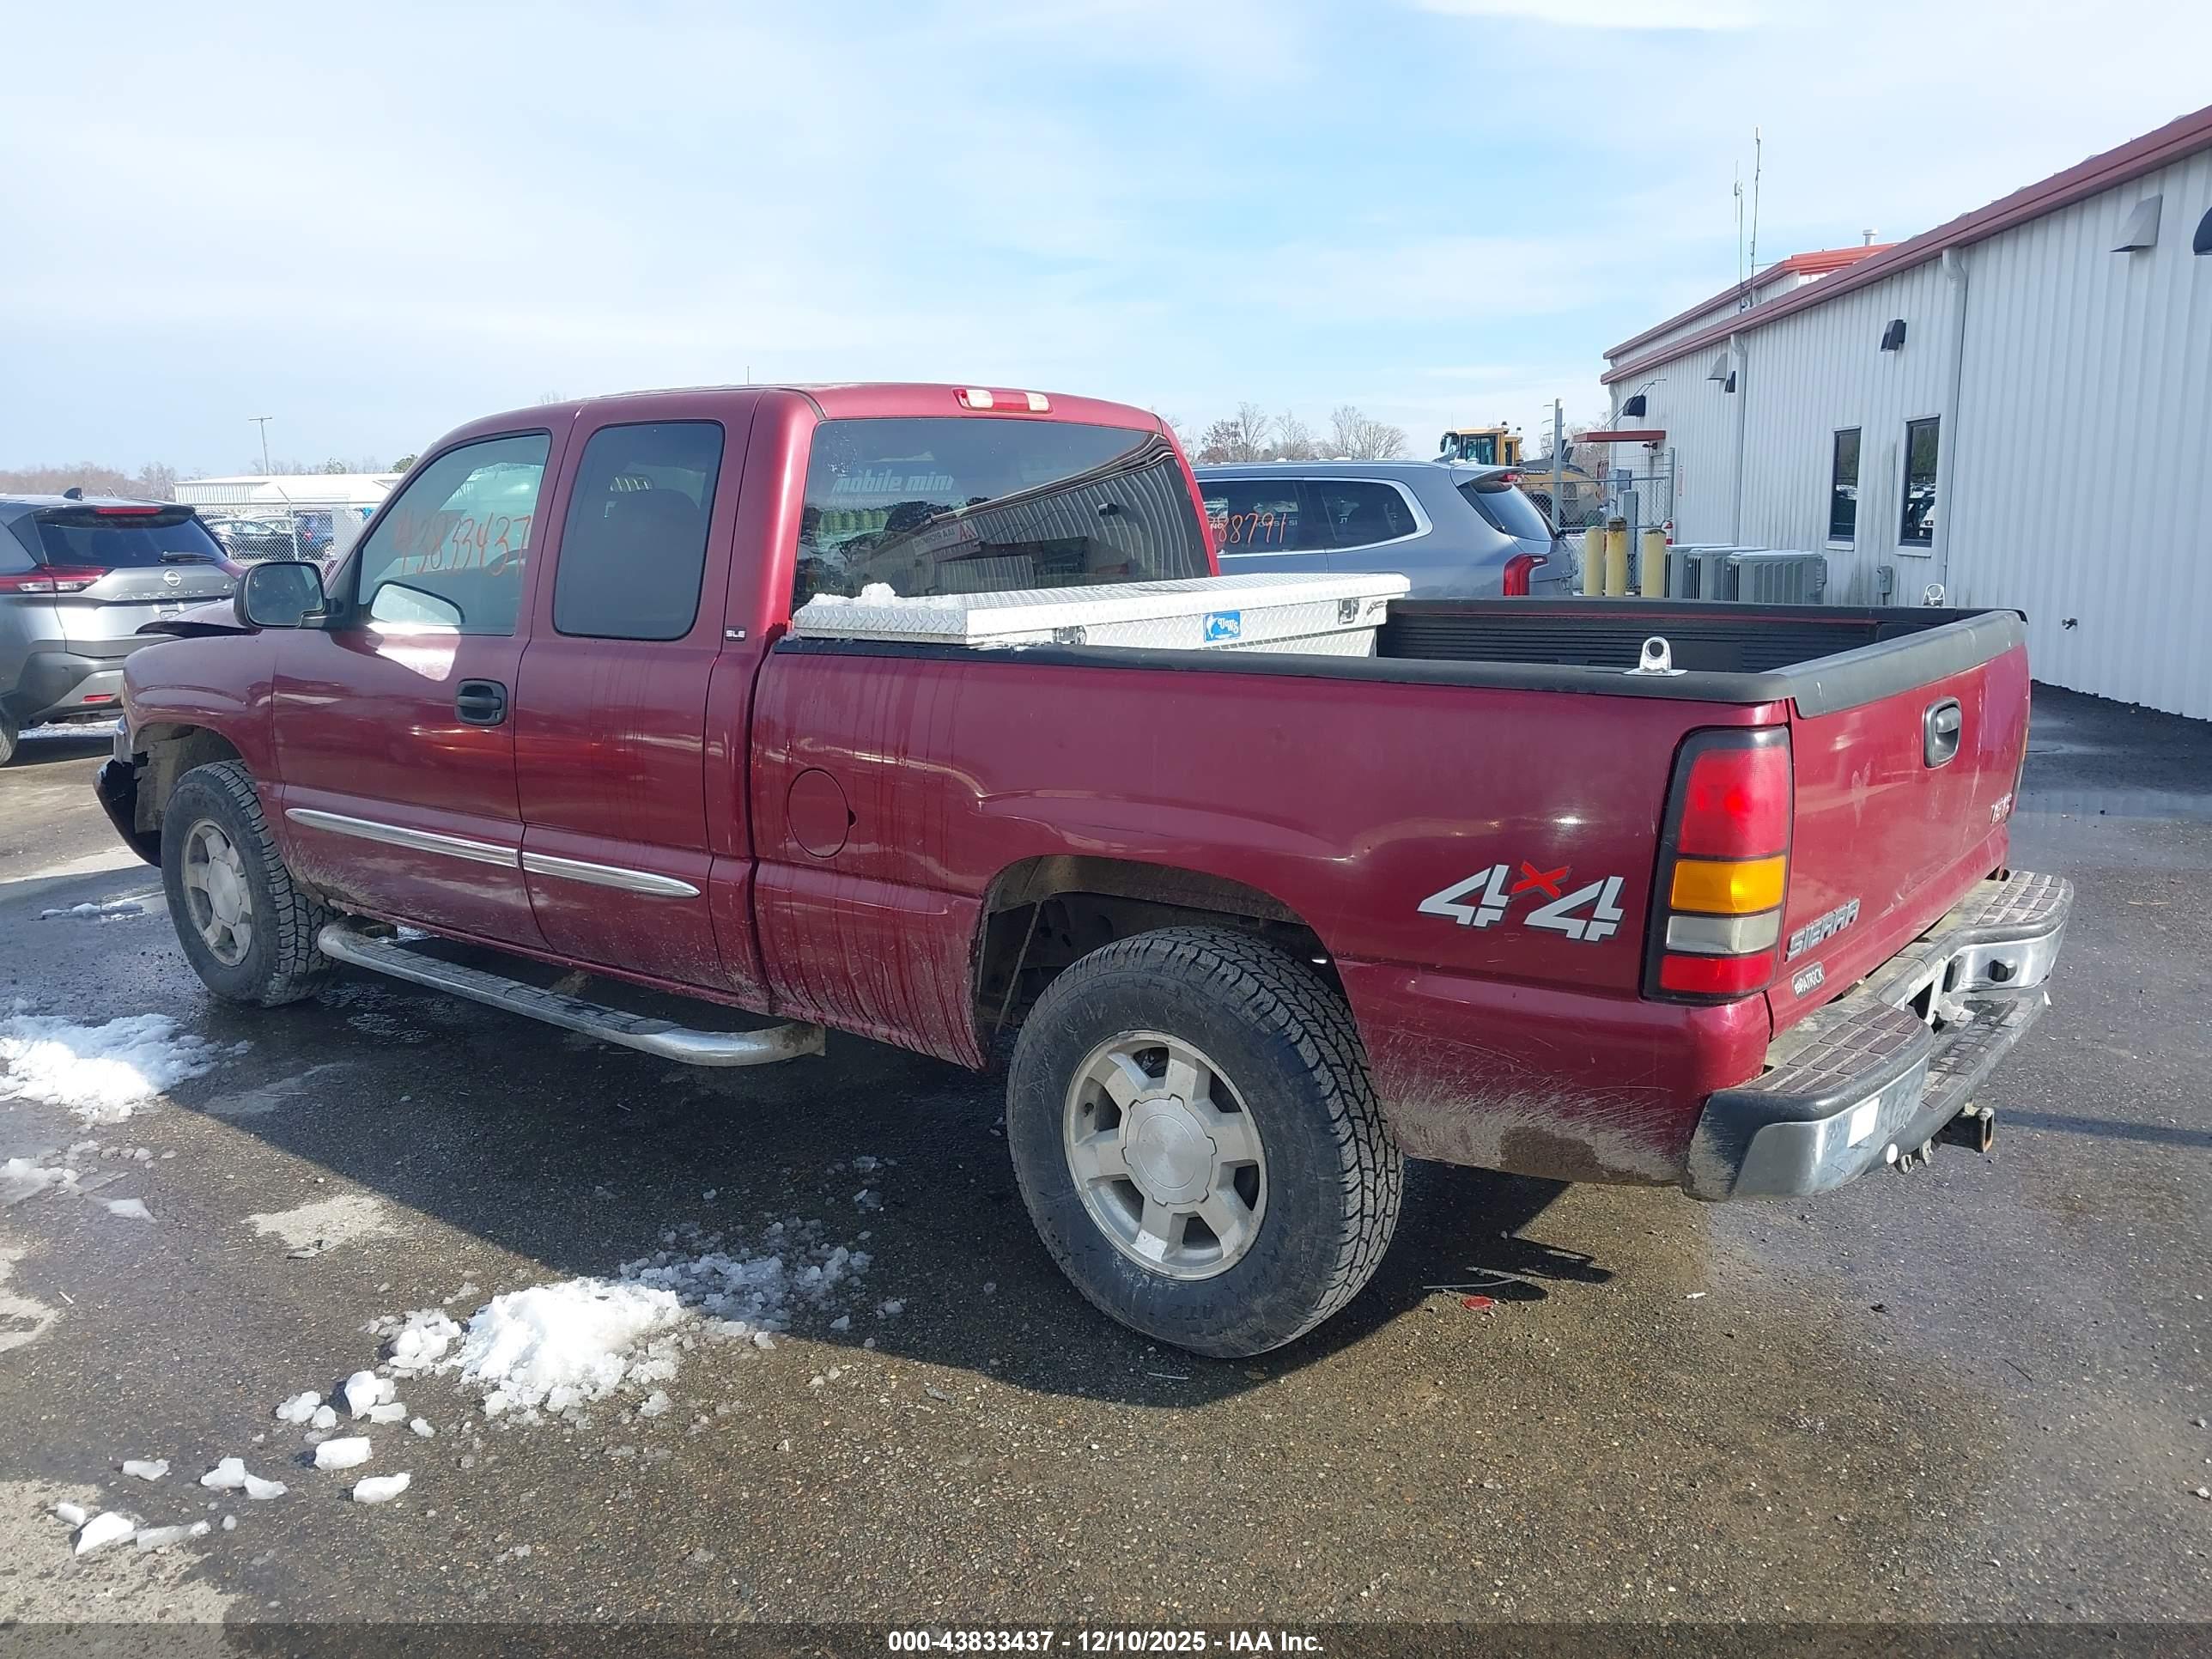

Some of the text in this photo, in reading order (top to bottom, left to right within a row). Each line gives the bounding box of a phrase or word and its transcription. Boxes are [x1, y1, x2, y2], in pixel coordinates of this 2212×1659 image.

[832, 469, 902, 493] mobile
[396, 508, 531, 577] 43833437
[726, 629, 745, 638] SLE
[1785, 899, 1860, 963] SIERRA
